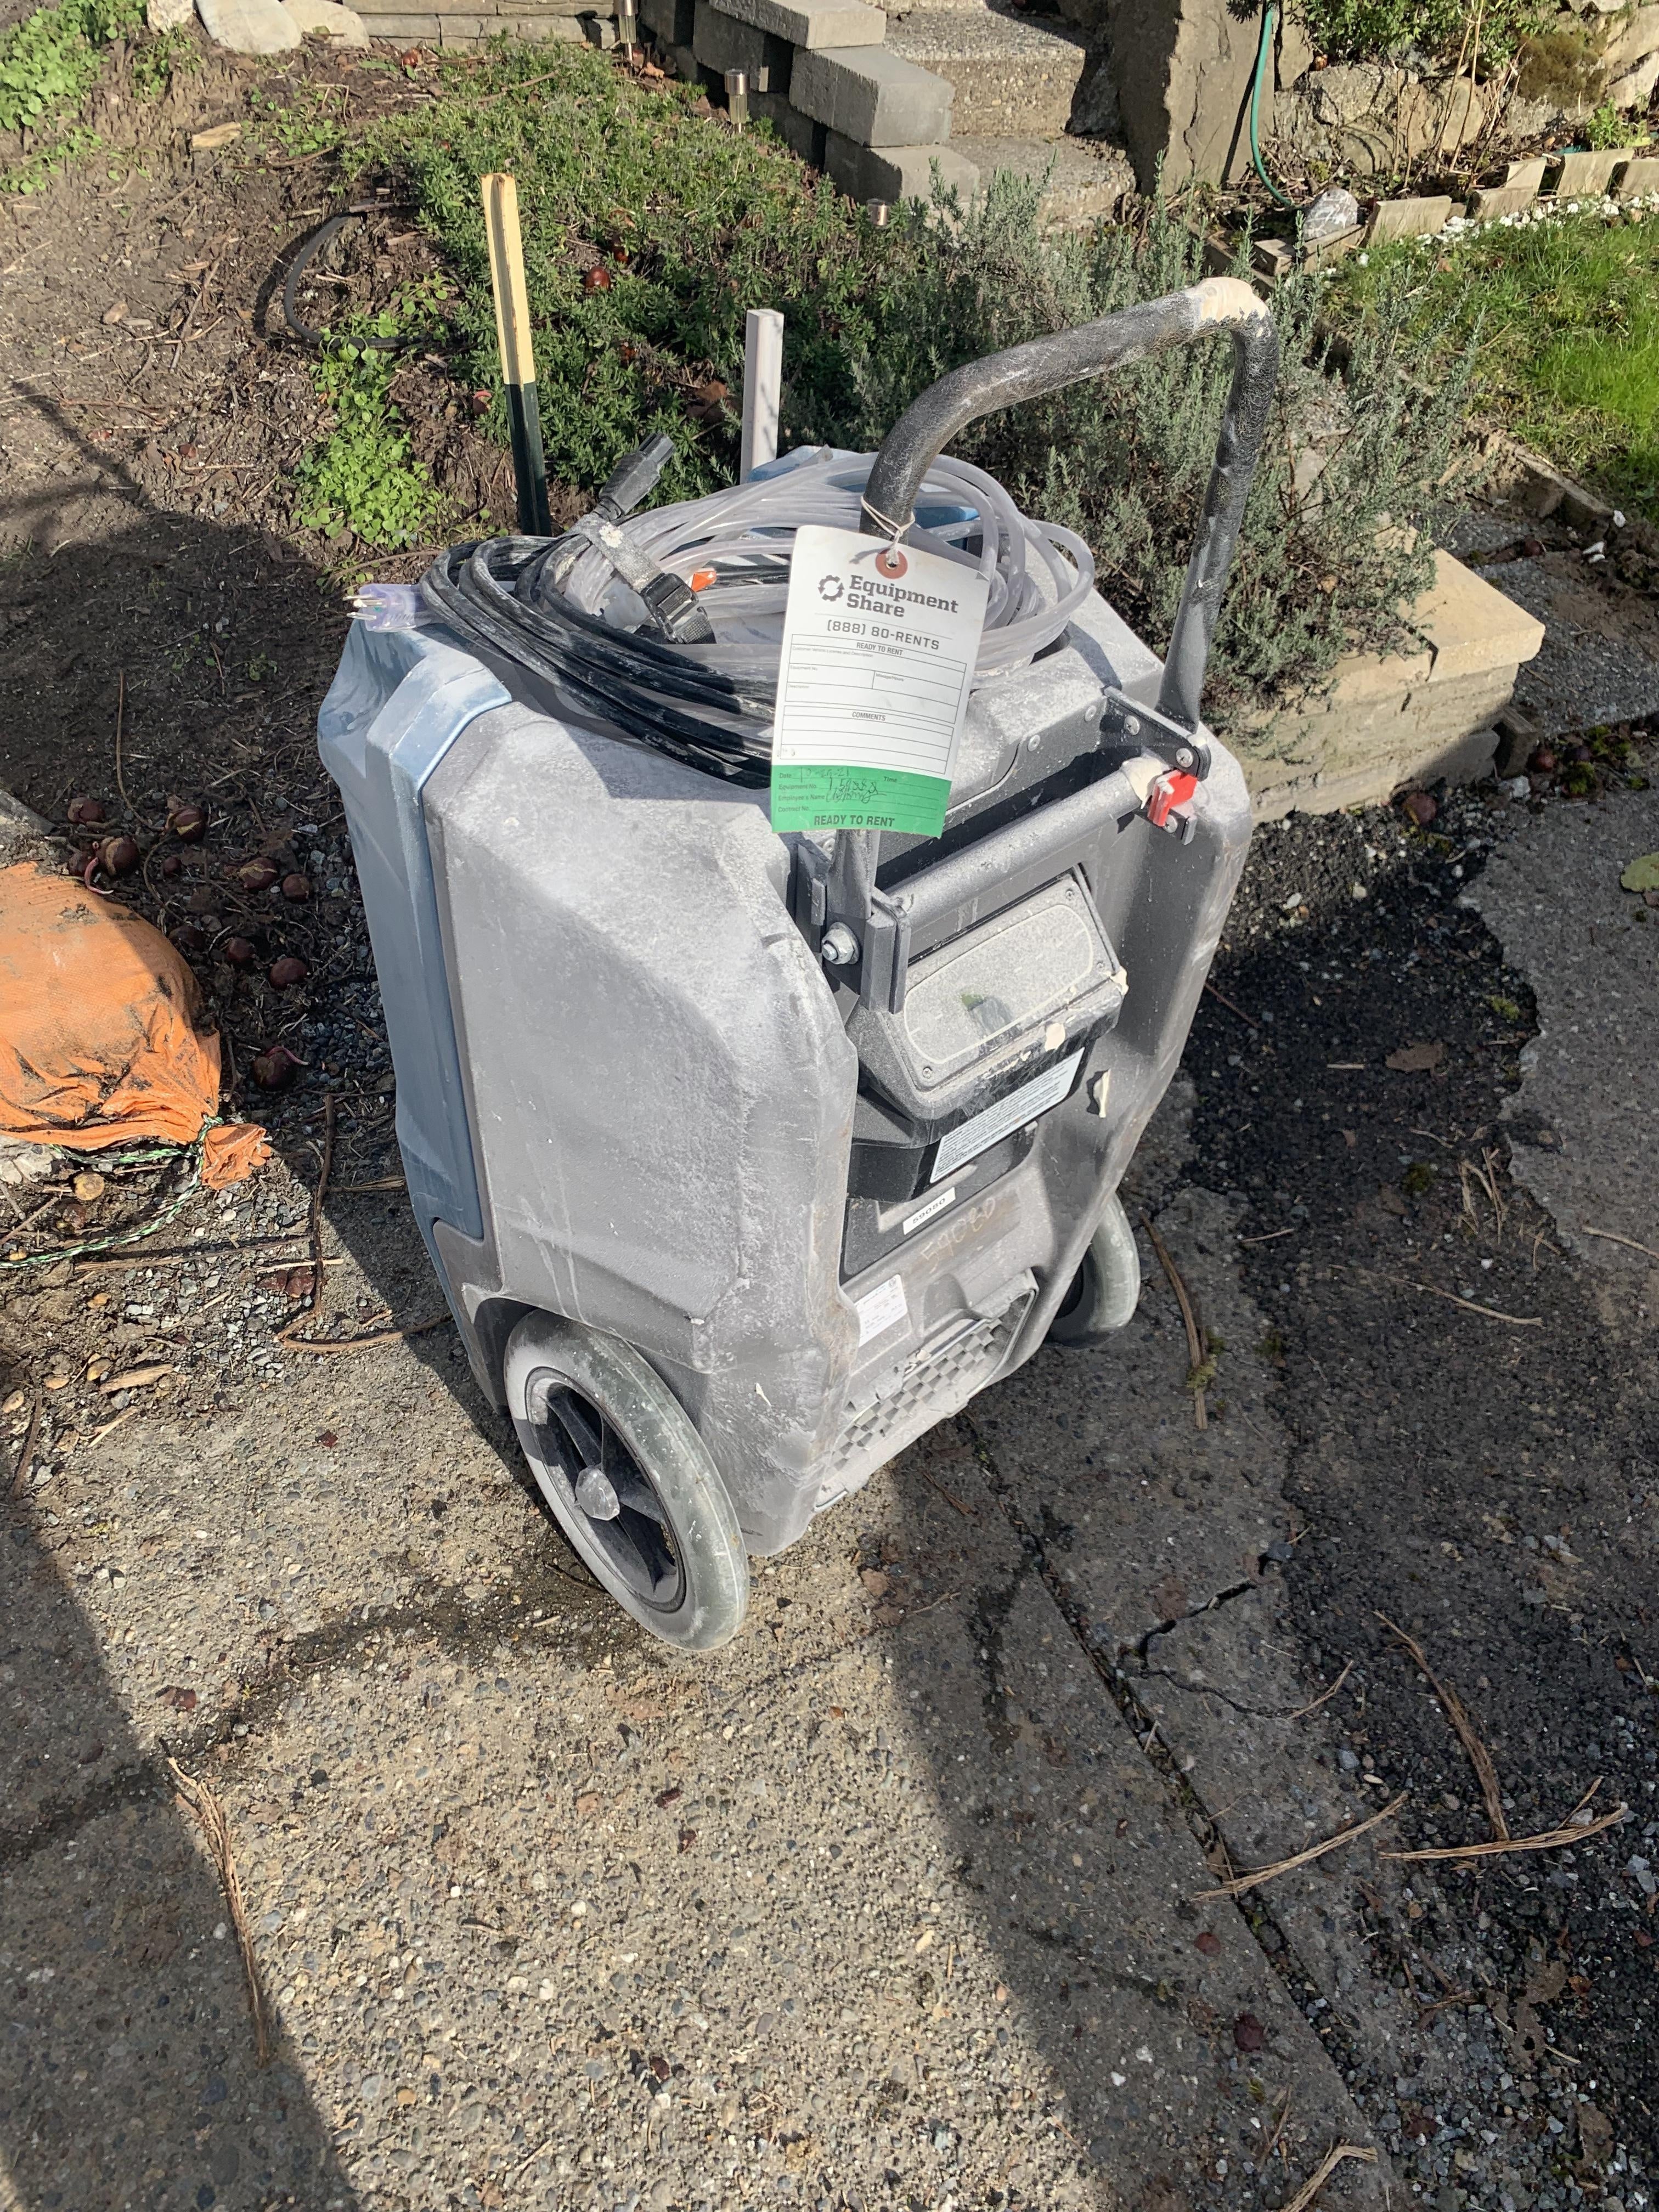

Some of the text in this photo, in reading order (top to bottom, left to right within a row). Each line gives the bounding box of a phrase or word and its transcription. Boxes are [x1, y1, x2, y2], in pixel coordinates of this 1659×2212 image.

[847, 594, 905, 617] Share
[849, 575, 959, 613] Equipment
[827, 619, 940, 650] (888) 80-RENTS
[856, 642, 877, 651] READY
[887, 646, 904, 656] RENT
[852, 712, 886, 721] COMMENTS
[814, 815, 895, 827] READY TO RENT
[913, 1198, 945, 1224] 59080
